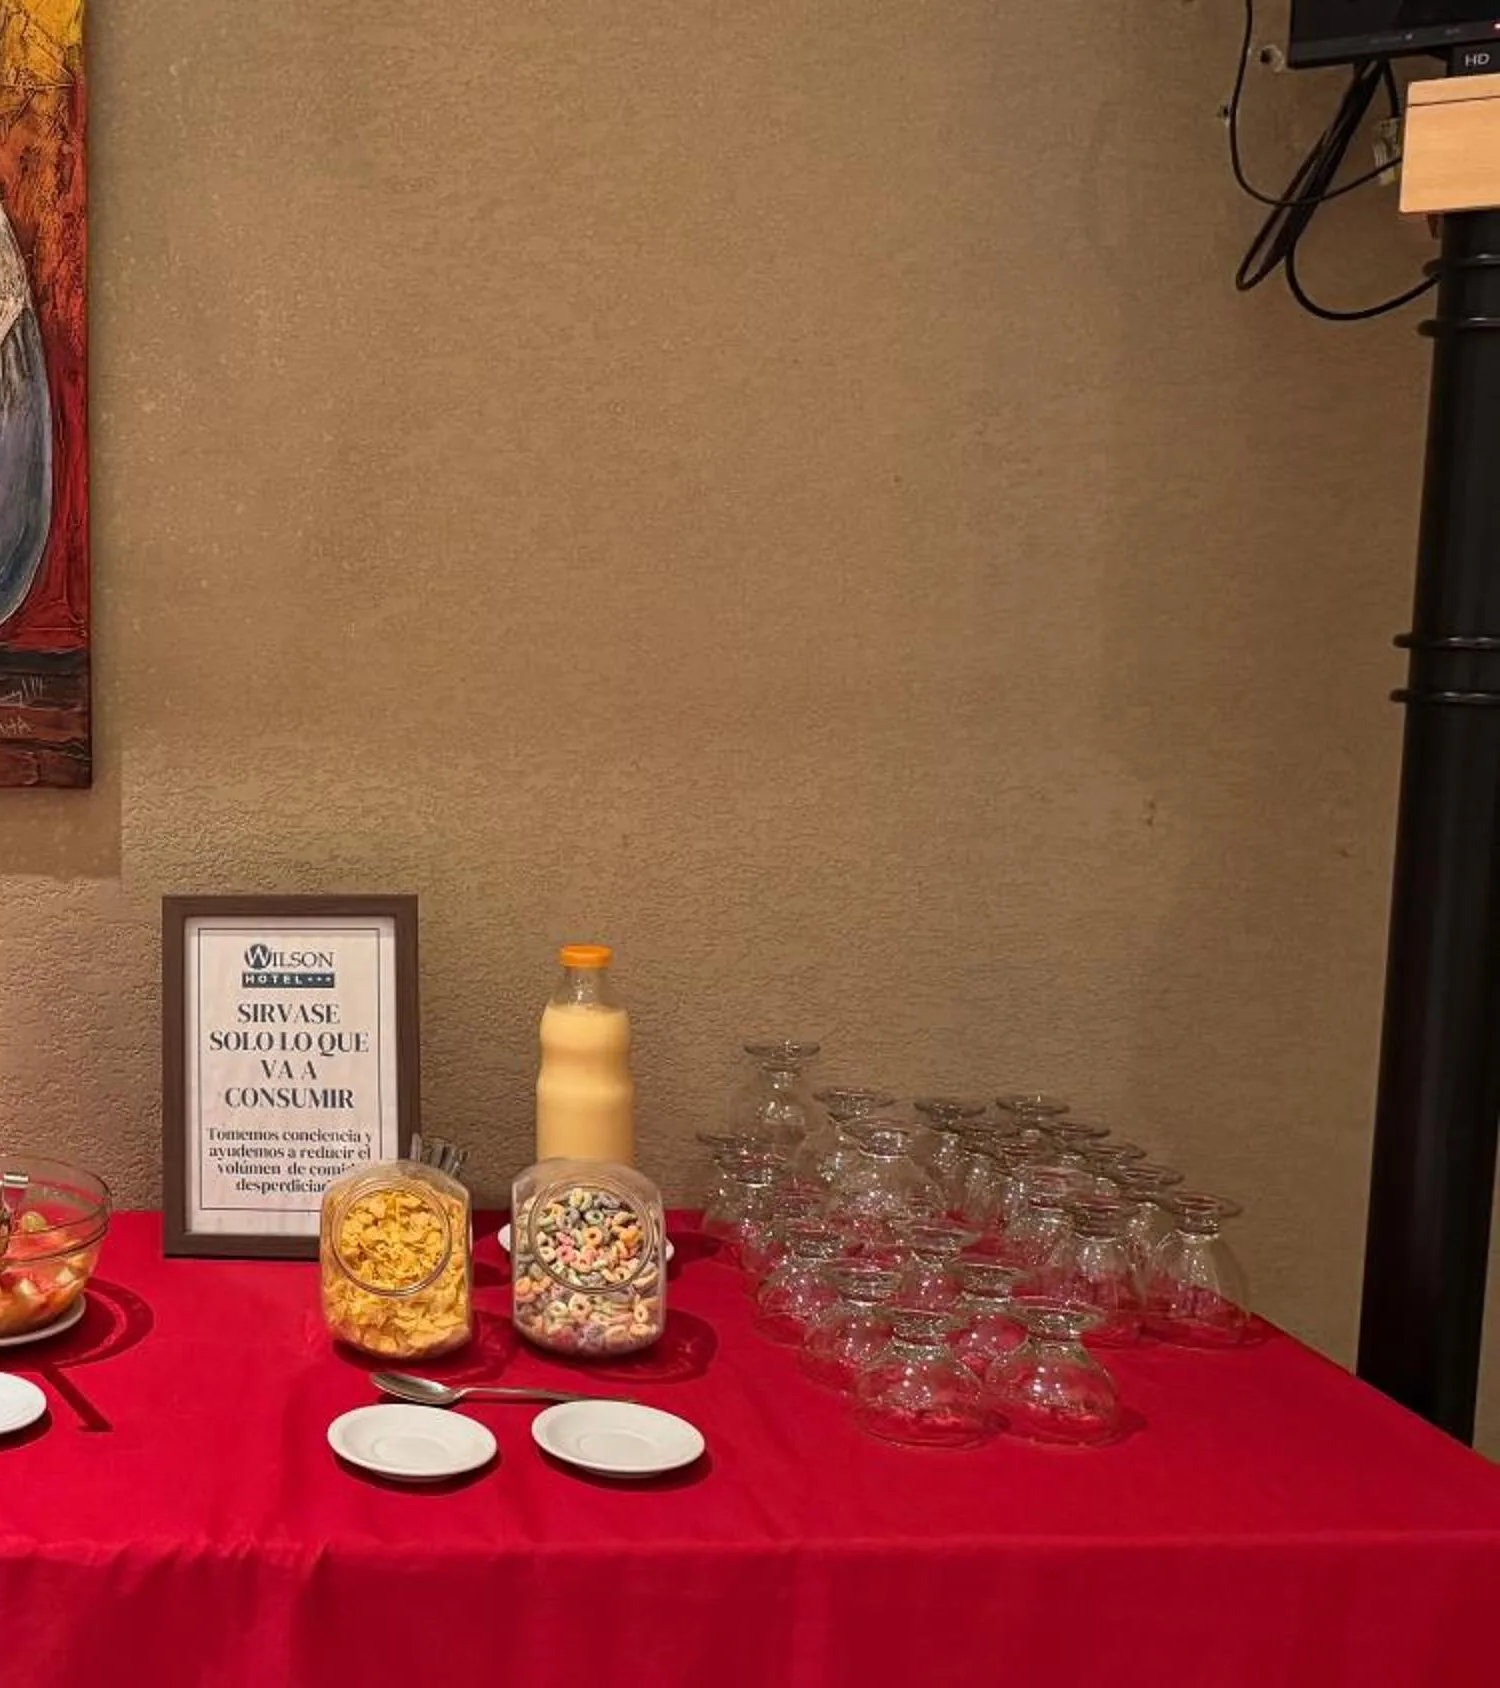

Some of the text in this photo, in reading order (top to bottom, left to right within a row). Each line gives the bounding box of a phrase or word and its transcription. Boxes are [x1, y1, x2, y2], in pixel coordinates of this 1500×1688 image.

[1465, 53, 1490, 67] HD
[244, 943, 334, 969] WILSON
[245, 974, 303, 985] HOTEL
[238, 1003, 341, 1025] SIRVASE
[209, 1031, 369, 1057] SOLO LO QUE
[261, 1059, 318, 1081] VA A
[225, 1087, 355, 1109] CONSUMIR
[206, 1127, 372, 1144] Tomemos conciencia y
[208, 1144, 372, 1161] ayudemos a reducir el
[287, 1161, 306, 1175] de
